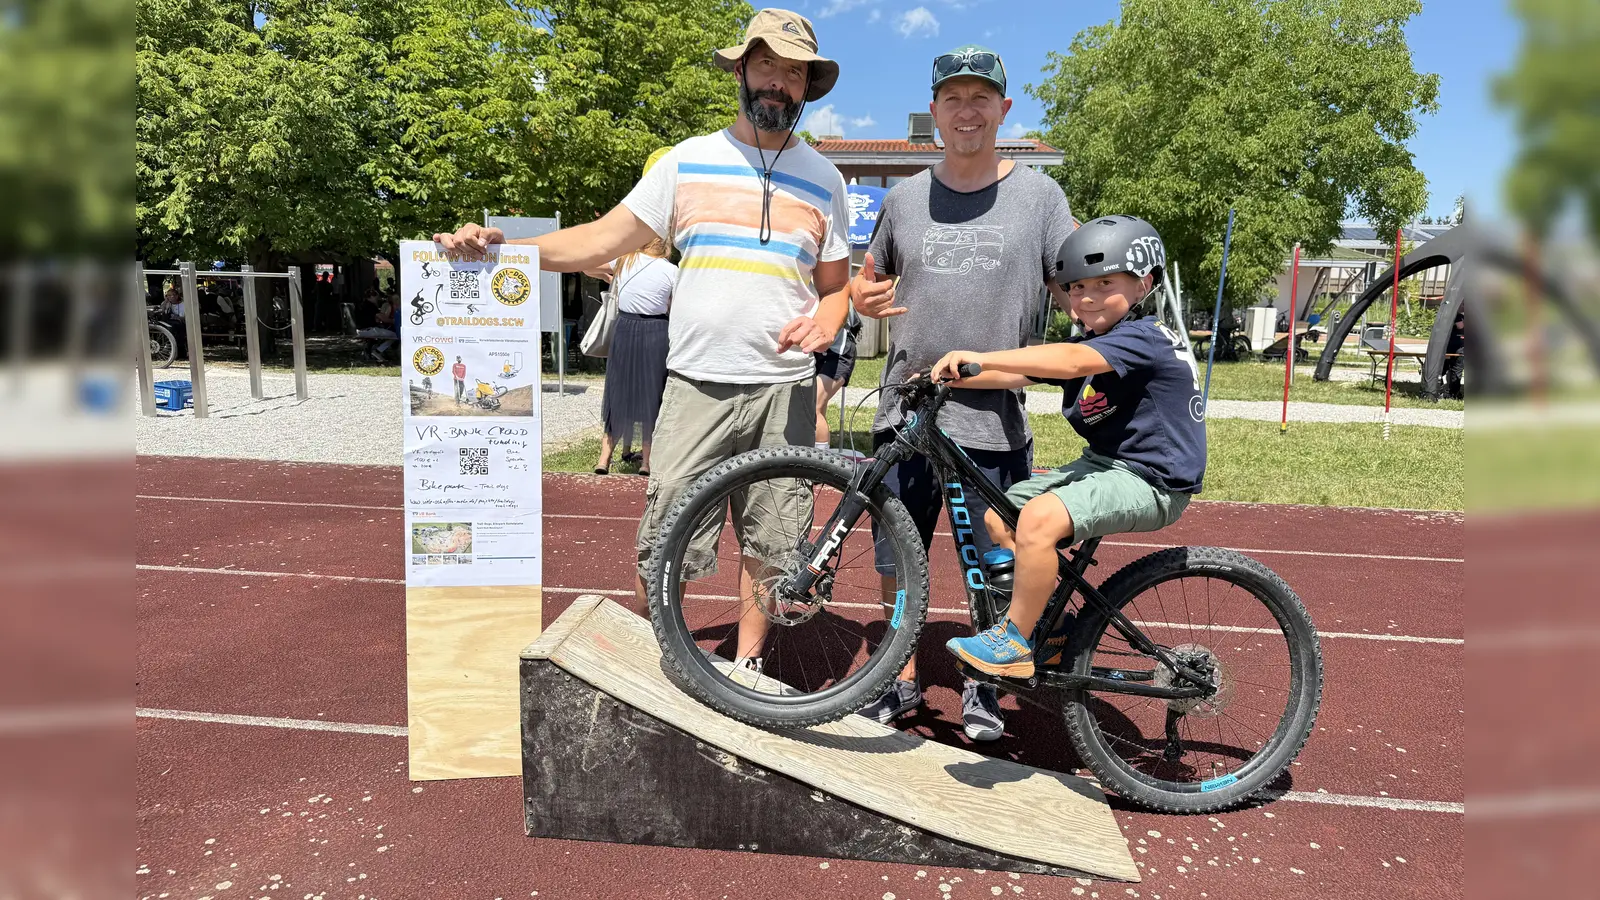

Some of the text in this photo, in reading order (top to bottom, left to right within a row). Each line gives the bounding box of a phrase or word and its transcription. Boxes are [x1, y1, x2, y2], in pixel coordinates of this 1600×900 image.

[412, 250, 460, 263] FOLLOW
[480, 252, 497, 263] ON
[500, 253, 530, 264] insta
[1103, 264, 1120, 272] uvex
[436, 316, 525, 327] @TRAILDOGS.SCW
[412, 335, 454, 344] VR-Crowd
